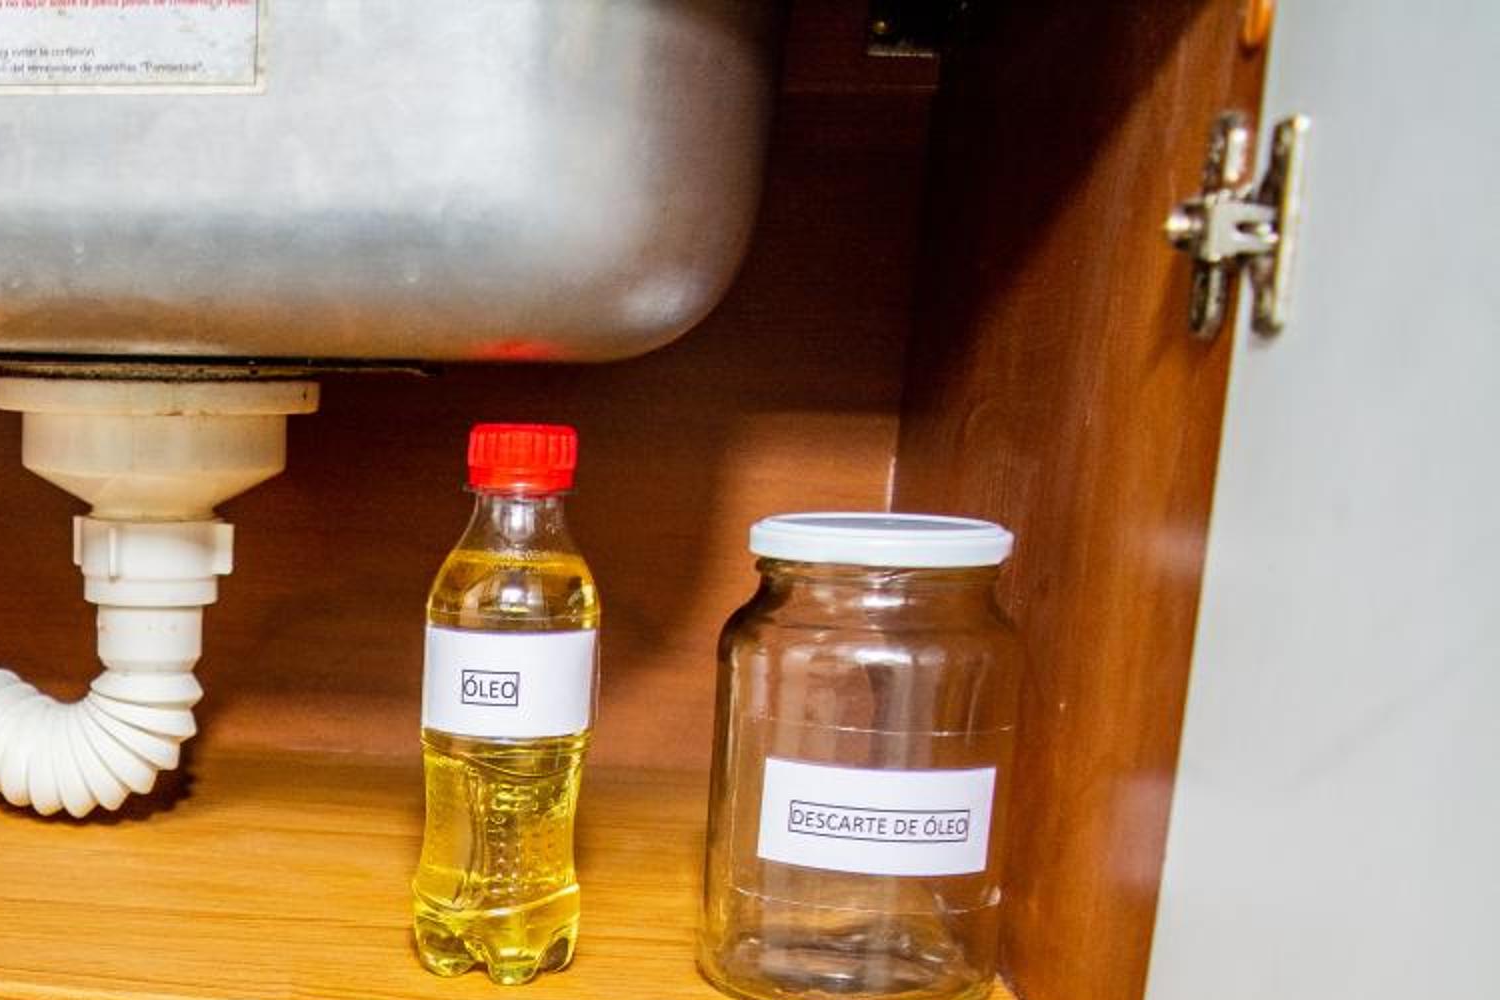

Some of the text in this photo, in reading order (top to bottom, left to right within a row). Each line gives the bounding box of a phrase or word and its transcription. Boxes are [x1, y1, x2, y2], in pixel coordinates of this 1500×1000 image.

[464, 675, 516, 699] ÓLEO
[791, 809, 967, 836] DESCARTE DE ÓLEO
